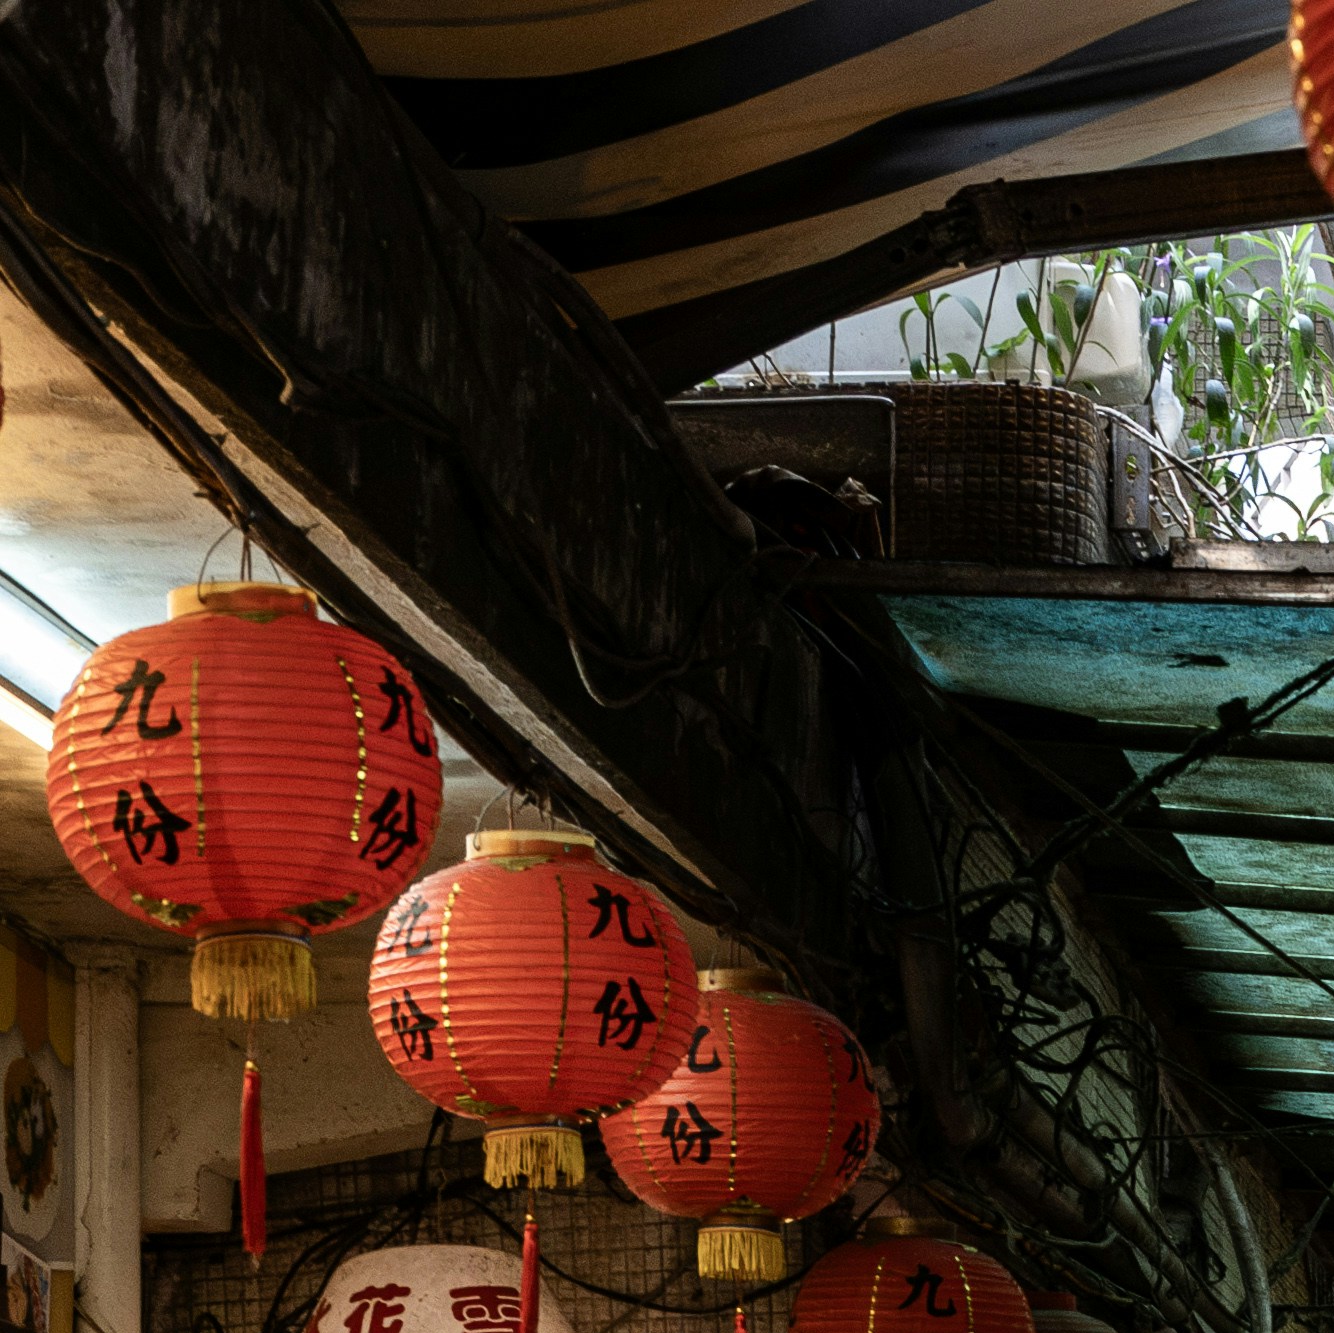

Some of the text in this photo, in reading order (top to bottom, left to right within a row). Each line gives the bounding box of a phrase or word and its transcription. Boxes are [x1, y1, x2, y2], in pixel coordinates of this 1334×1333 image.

[102, 659, 192, 867] 九份
[359, 666, 432, 871] 九份
[383, 894, 438, 1063] 九份
[587, 884, 658, 1051] 九份
